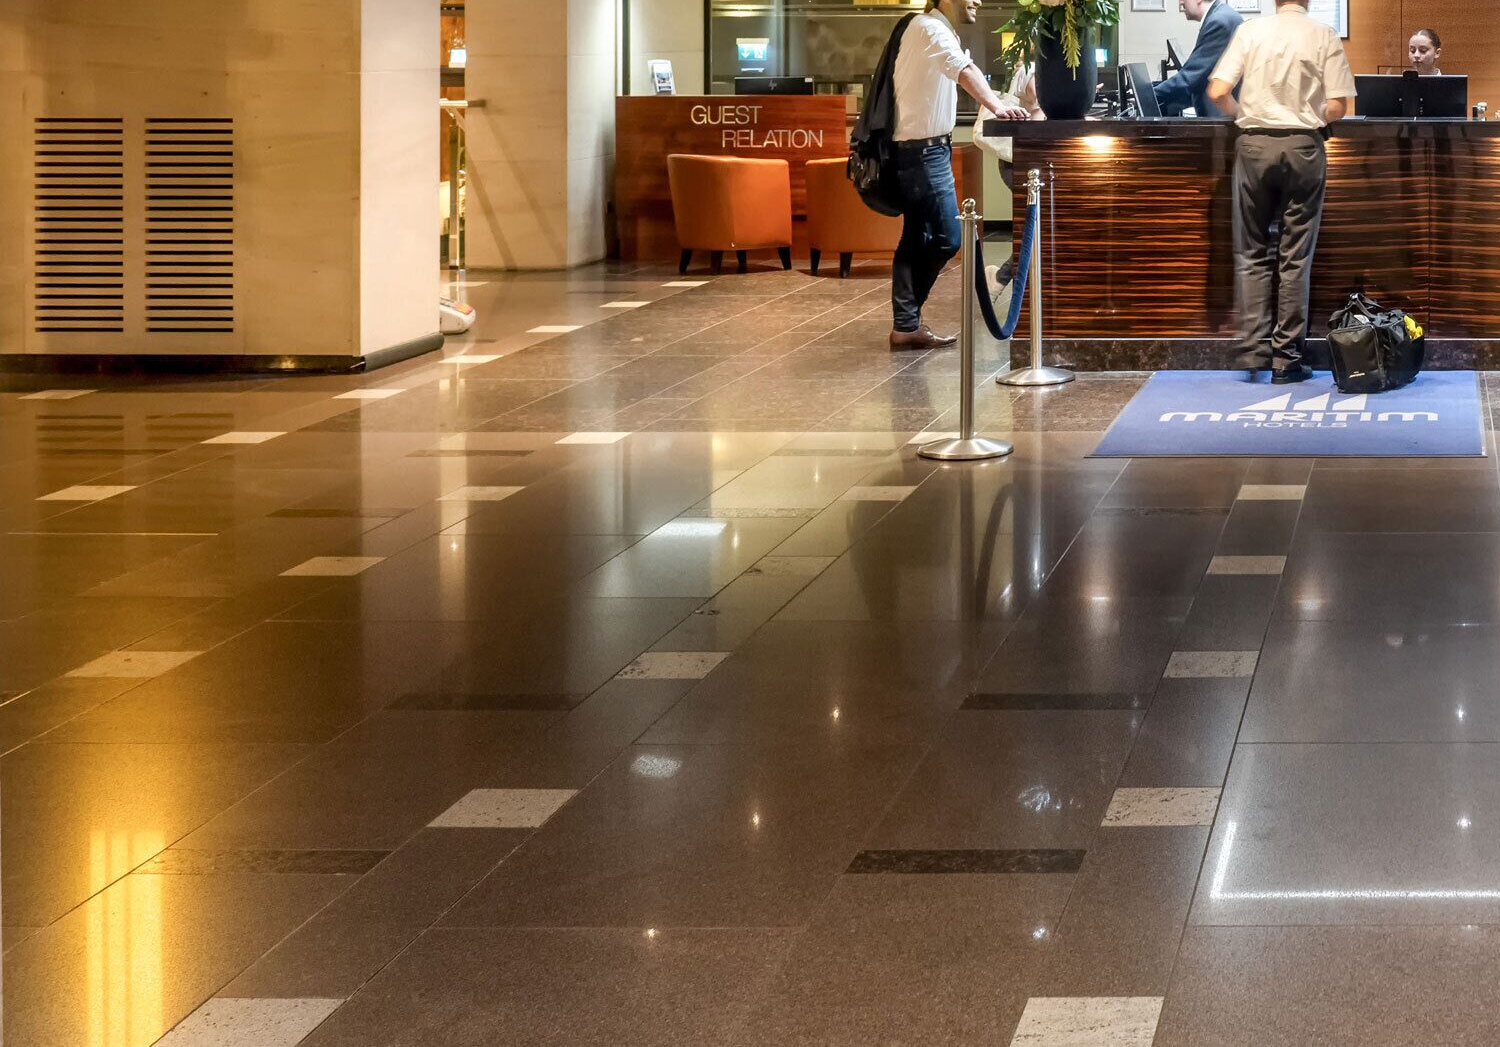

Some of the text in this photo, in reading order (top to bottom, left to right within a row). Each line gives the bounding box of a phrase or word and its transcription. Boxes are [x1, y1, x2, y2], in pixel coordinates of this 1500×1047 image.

[690, 105, 763, 124] GUEST
[722, 129, 823, 148] RELATION
[1159, 411, 1438, 422] MARITIM
